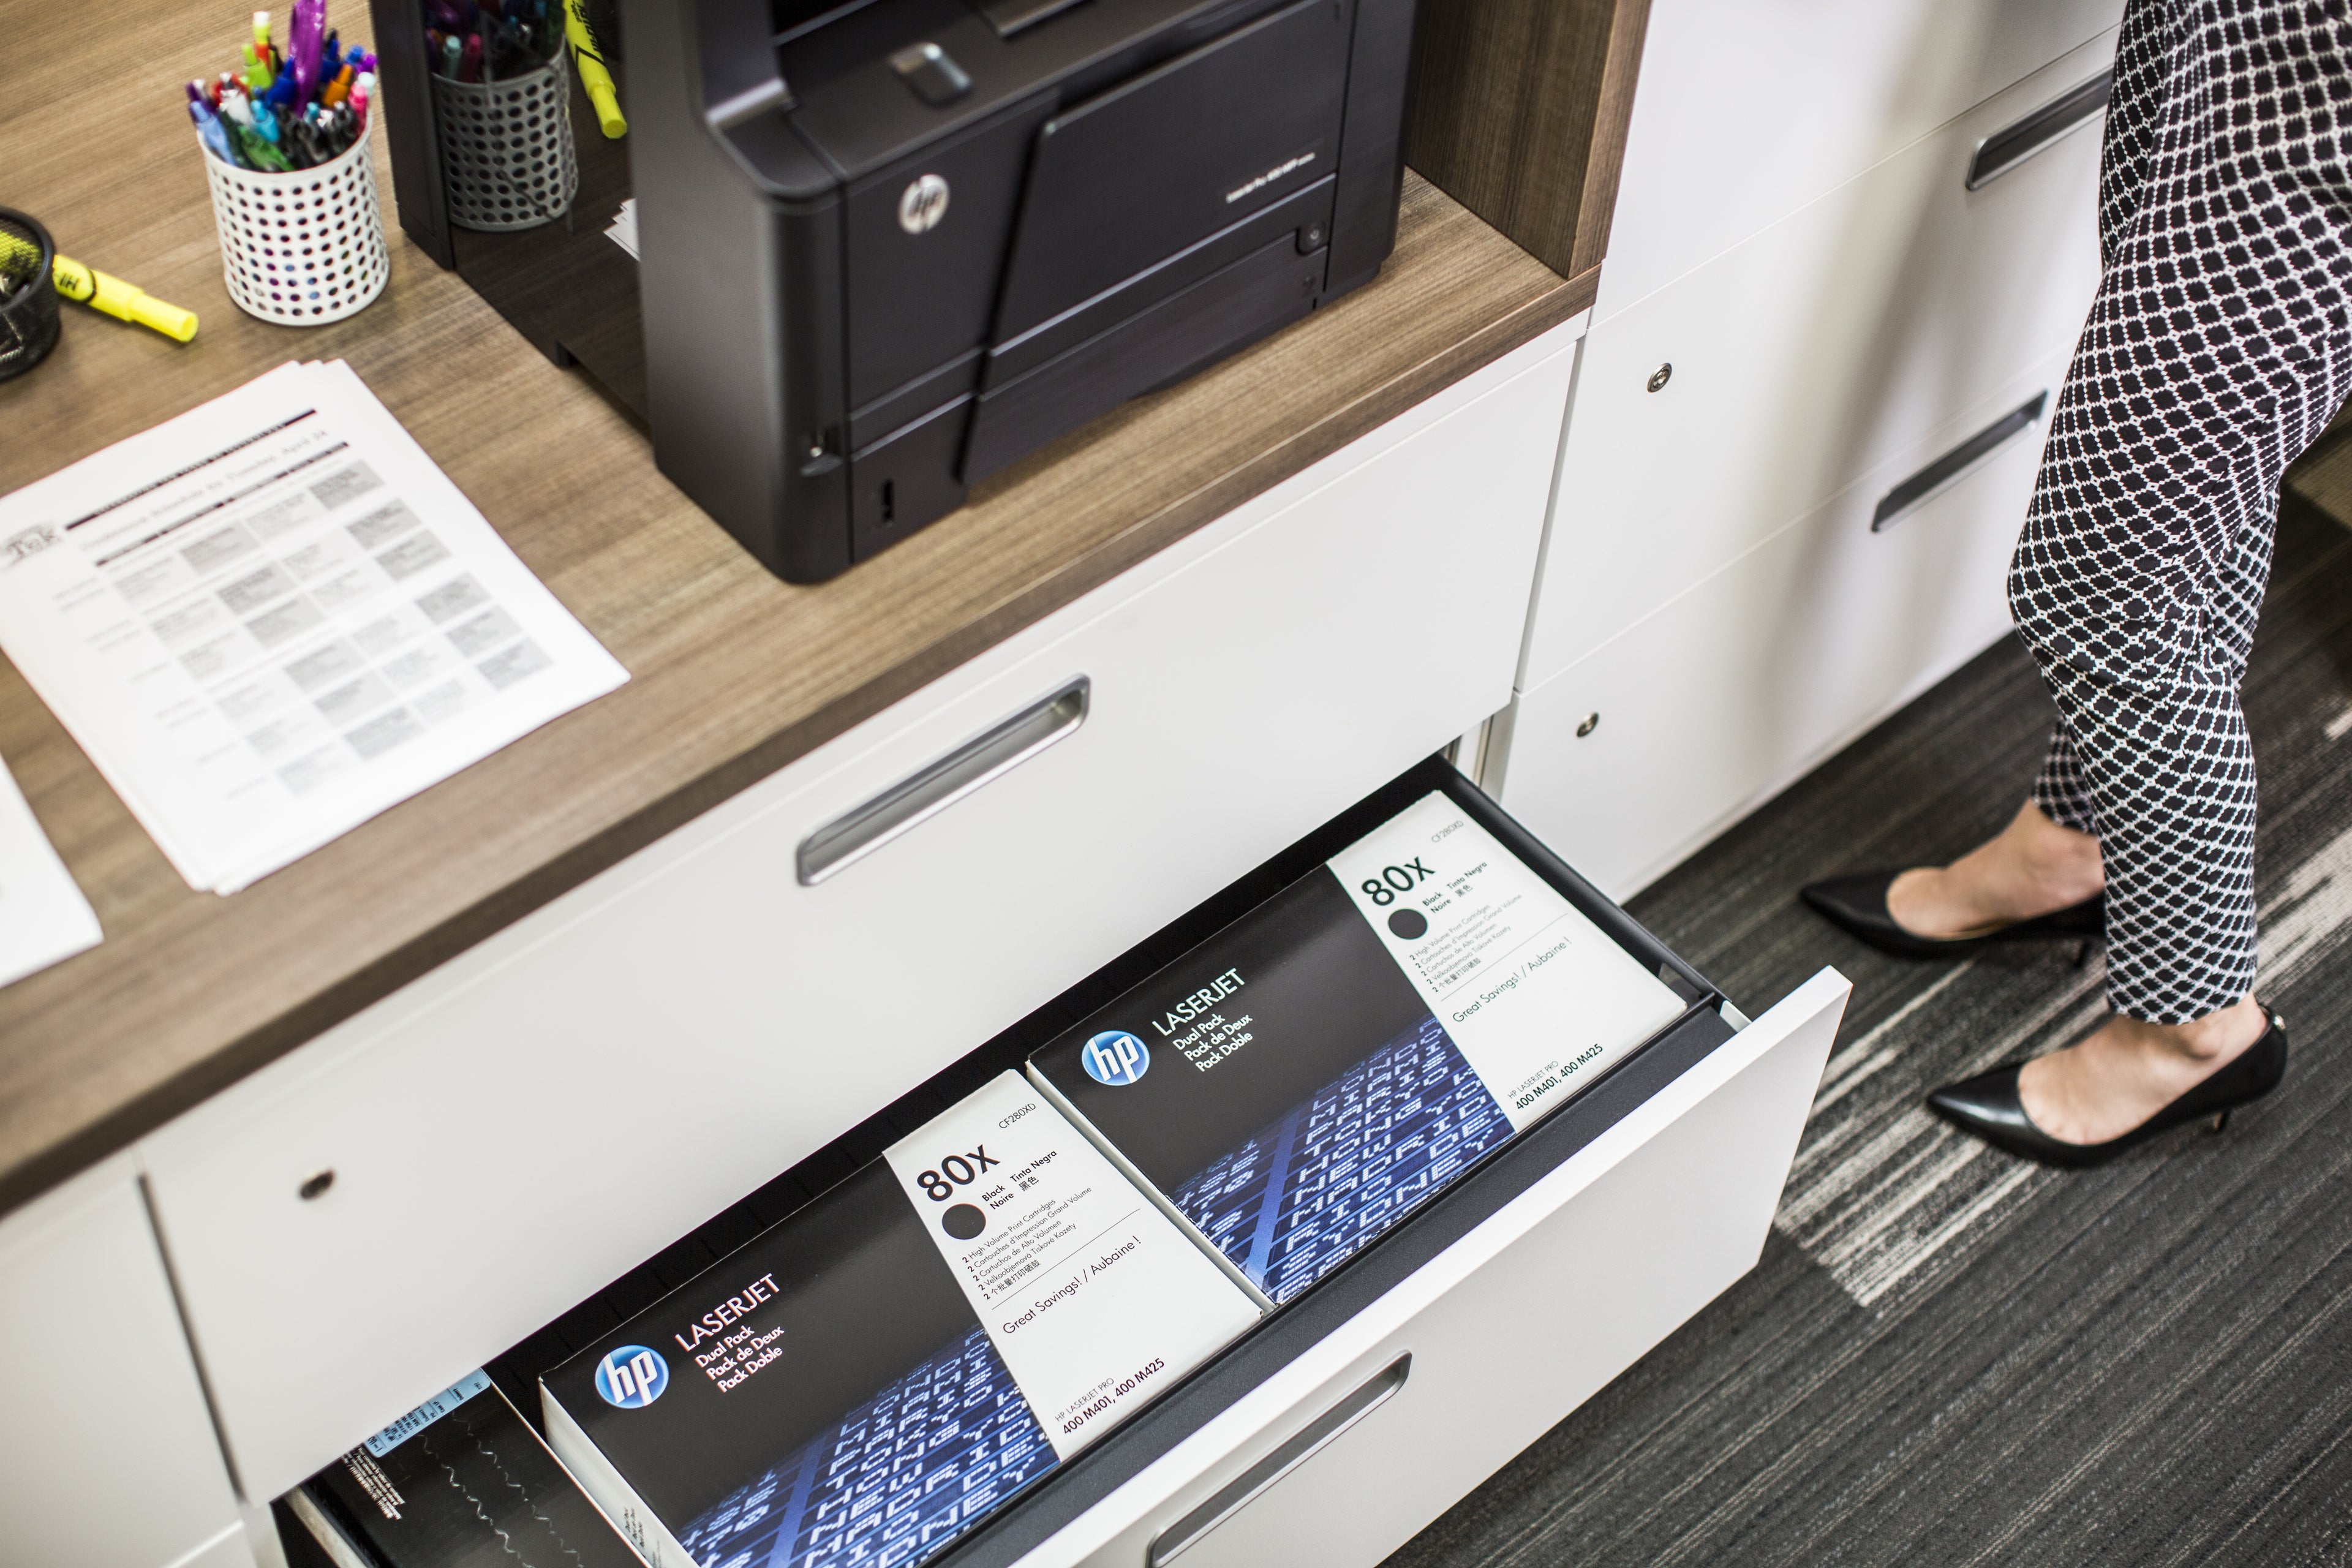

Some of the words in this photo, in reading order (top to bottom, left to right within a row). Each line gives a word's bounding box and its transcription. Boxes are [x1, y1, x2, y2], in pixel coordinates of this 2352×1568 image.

[1431, 820, 1464, 843] CF280XD
[1361, 856, 1436, 906] 80x
[1422, 892, 1442, 907] Black
[1446, 877, 1465, 889] Tinta
[1464, 862, 1487, 878] Negra
[1455, 884, 1473, 897] 黑色
[1414, 946, 1430, 957] High
[1428, 933, 1450, 946] Volume
[1449, 924, 1462, 933] Print
[1461, 905, 1490, 924] Cartridges
[1421, 943, 1452, 965] Cartouches
[1483, 907, 1502, 921] Grand
[1501, 895, 1522, 908] Volume
[1430, 900, 1451, 913] Noire
[1491, 926, 1511, 939] Kazety
[1427, 954, 1455, 973] Cartuchos
[1463, 940, 1474, 949] Alto
[1473, 924, 1497, 940] Volumen
[1152, 967, 1245, 1036] LASERJET
[1453, 1001, 1482, 1022] Great
[1480, 972, 1521, 1003] Savings!
[1528, 943, 1566, 971] Aubaine
[1172, 1027, 1202, 1050] Dual
[1197, 1013, 1226, 1034] Pack
[1183, 1040, 1213, 1061] Pack
[1210, 1032, 1226, 1045] de
[1221, 1014, 1253, 1036] Deux
[1195, 1051, 1224, 1072] Pack
[1218, 1031, 1253, 1056] Doble
[1087, 1035, 1140, 1084] hp
[1310, 1041, 1441, 1128] MIAMI
[1507, 1090, 1517, 1099] HP
[1517, 1070, 1545, 1092] LASERJET
[1544, 1061, 1558, 1072] PRO
[1517, 1094, 1534, 1109] 400
[1532, 1076, 1561, 1097] M401,
[1561, 1062, 1578, 1077] 400
[1577, 1044, 1603, 1065] M425
[999, 1104, 1036, 1128] CF280XD
[1304, 1066, 1448, 1156] TOKYO
[1306, 1051, 1446, 1145] PARIS
[1010, 1168, 1031, 1182] Tinta
[1030, 1151, 1057, 1169] Negra
[1288, 1090, 1486, 1233] MADRID
[1298, 1097, 1422, 1183] HONG
[917, 1144, 1000, 1202] 80x
[982, 1185, 1005, 1201] Black
[1019, 1177, 1039, 1191] 黑色
[1294, 1134, 1391, 1205] NEW
[968, 1246, 986, 1259] High
[984, 1232, 1009, 1247] Volume
[1008, 1221, 1023, 1232] Print
[1023, 1200, 1055, 1221] Cartridges
[974, 1244, 1009, 1267] Cartouches
[1047, 1201, 1068, 1218] Grand
[1067, 1188, 1091, 1203] Volume
[990, 1194, 1014, 1210] Noire
[1280, 1129, 1493, 1284] SYDNEY
[1286, 1175, 1392, 1253] RIO
[979, 1255, 1011, 1276] Cartuchos
[1022, 1240, 1035, 1250] Alto
[1033, 1221, 1061, 1238] Volumen
[1054, 1223, 1076, 1238] Kazety
[674, 1273, 780, 1352] LASERJET
[1003, 1309, 1036, 1333] Great
[1035, 1276, 1082, 1311] Savings!
[1091, 1243, 1134, 1275] Aubaine
[695, 1341, 727, 1368] Dual
[723, 1325, 755, 1349] Pack
[706, 1356, 738, 1381] Pack
[736, 1347, 754, 1363] de
[750, 1326, 785, 1351] Deux
[717, 1369, 749, 1393] Pack
[744, 1347, 783, 1374] Doble
[603, 1351, 658, 1406] hp
[835, 1355, 986, 1456] MIAMI
[1055, 1412, 1065, 1422] HP
[1066, 1388, 1098, 1414] LASERJET
[1098, 1378, 1114, 1391] PRO
[1064, 1416, 1084, 1434] 400
[1083, 1396, 1115, 1420] M401,
[1116, 1379, 1135, 1396] 400
[1134, 1358, 1164, 1383] M425
[826, 1384, 992, 1489] TOKYO
[829, 1367, 992, 1476] PARIS
[804, 1418, 1033, 1568] MADRID
[817, 1420, 959, 1520] HONG
[810, 1463, 922, 1545] NEW
